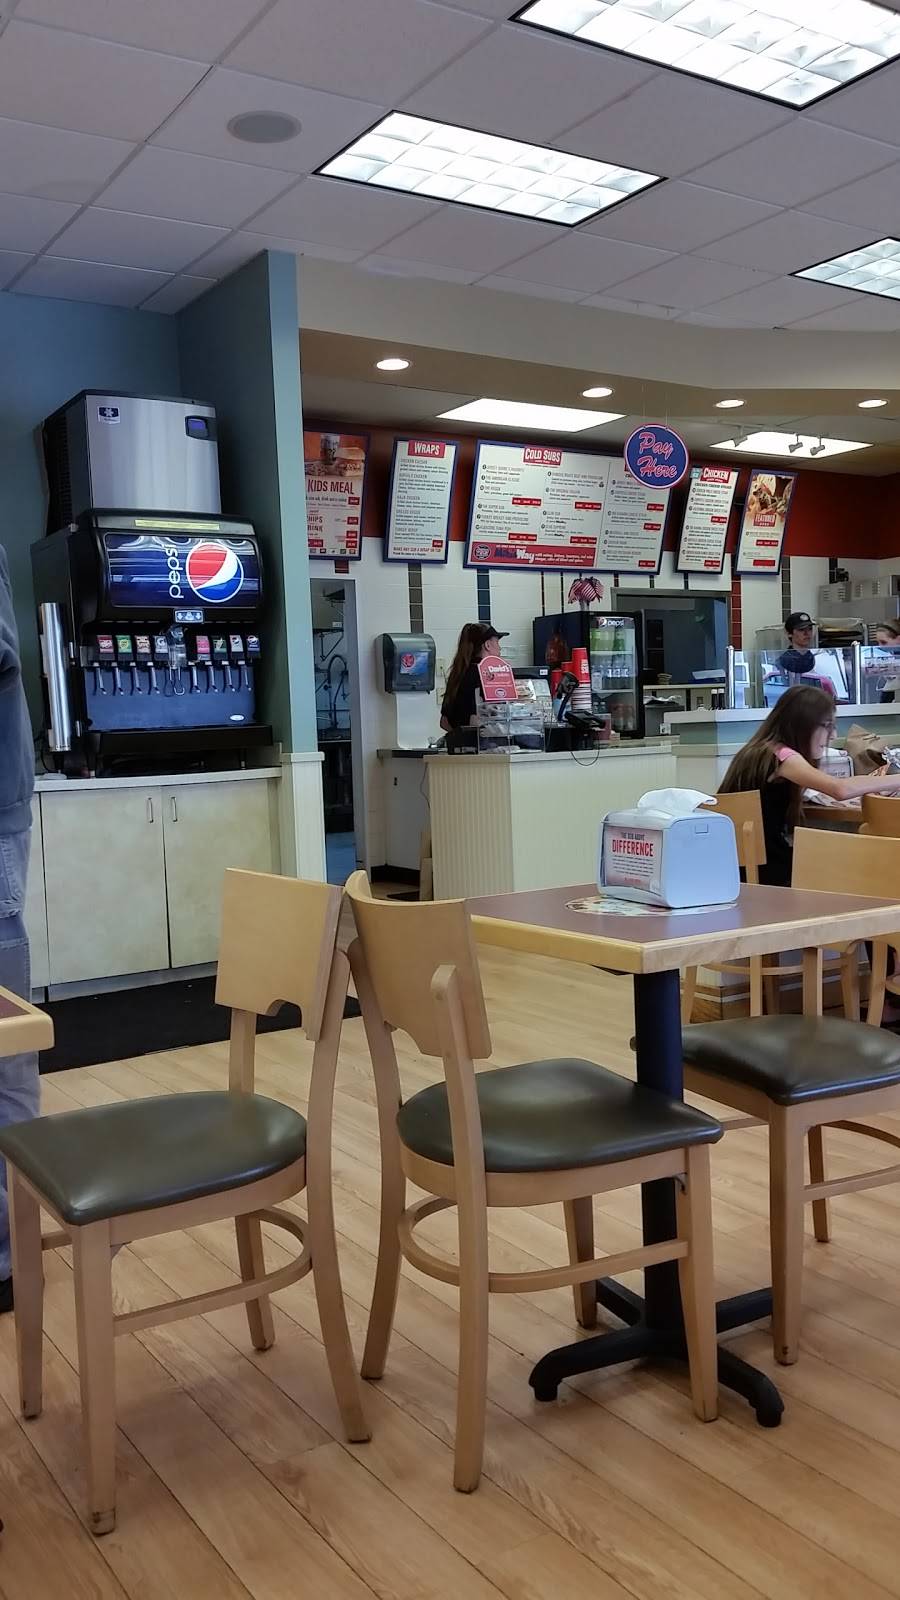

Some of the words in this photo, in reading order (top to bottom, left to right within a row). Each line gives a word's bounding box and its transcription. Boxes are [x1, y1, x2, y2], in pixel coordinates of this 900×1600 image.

[414, 442, 440, 455] WRAPS
[639, 432, 674, 460] Pay
[525, 448, 542, 460] COLD
[543, 450, 561, 462] SUBS
[636, 455, 677, 478] Here
[703, 467, 729, 481] CHICKEN
[307, 479, 328, 493] KIDS
[330, 481, 354, 495] MEAL
[165, 545, 184, 599] pepsi
[612, 839, 654, 857] DIFFERENCE
